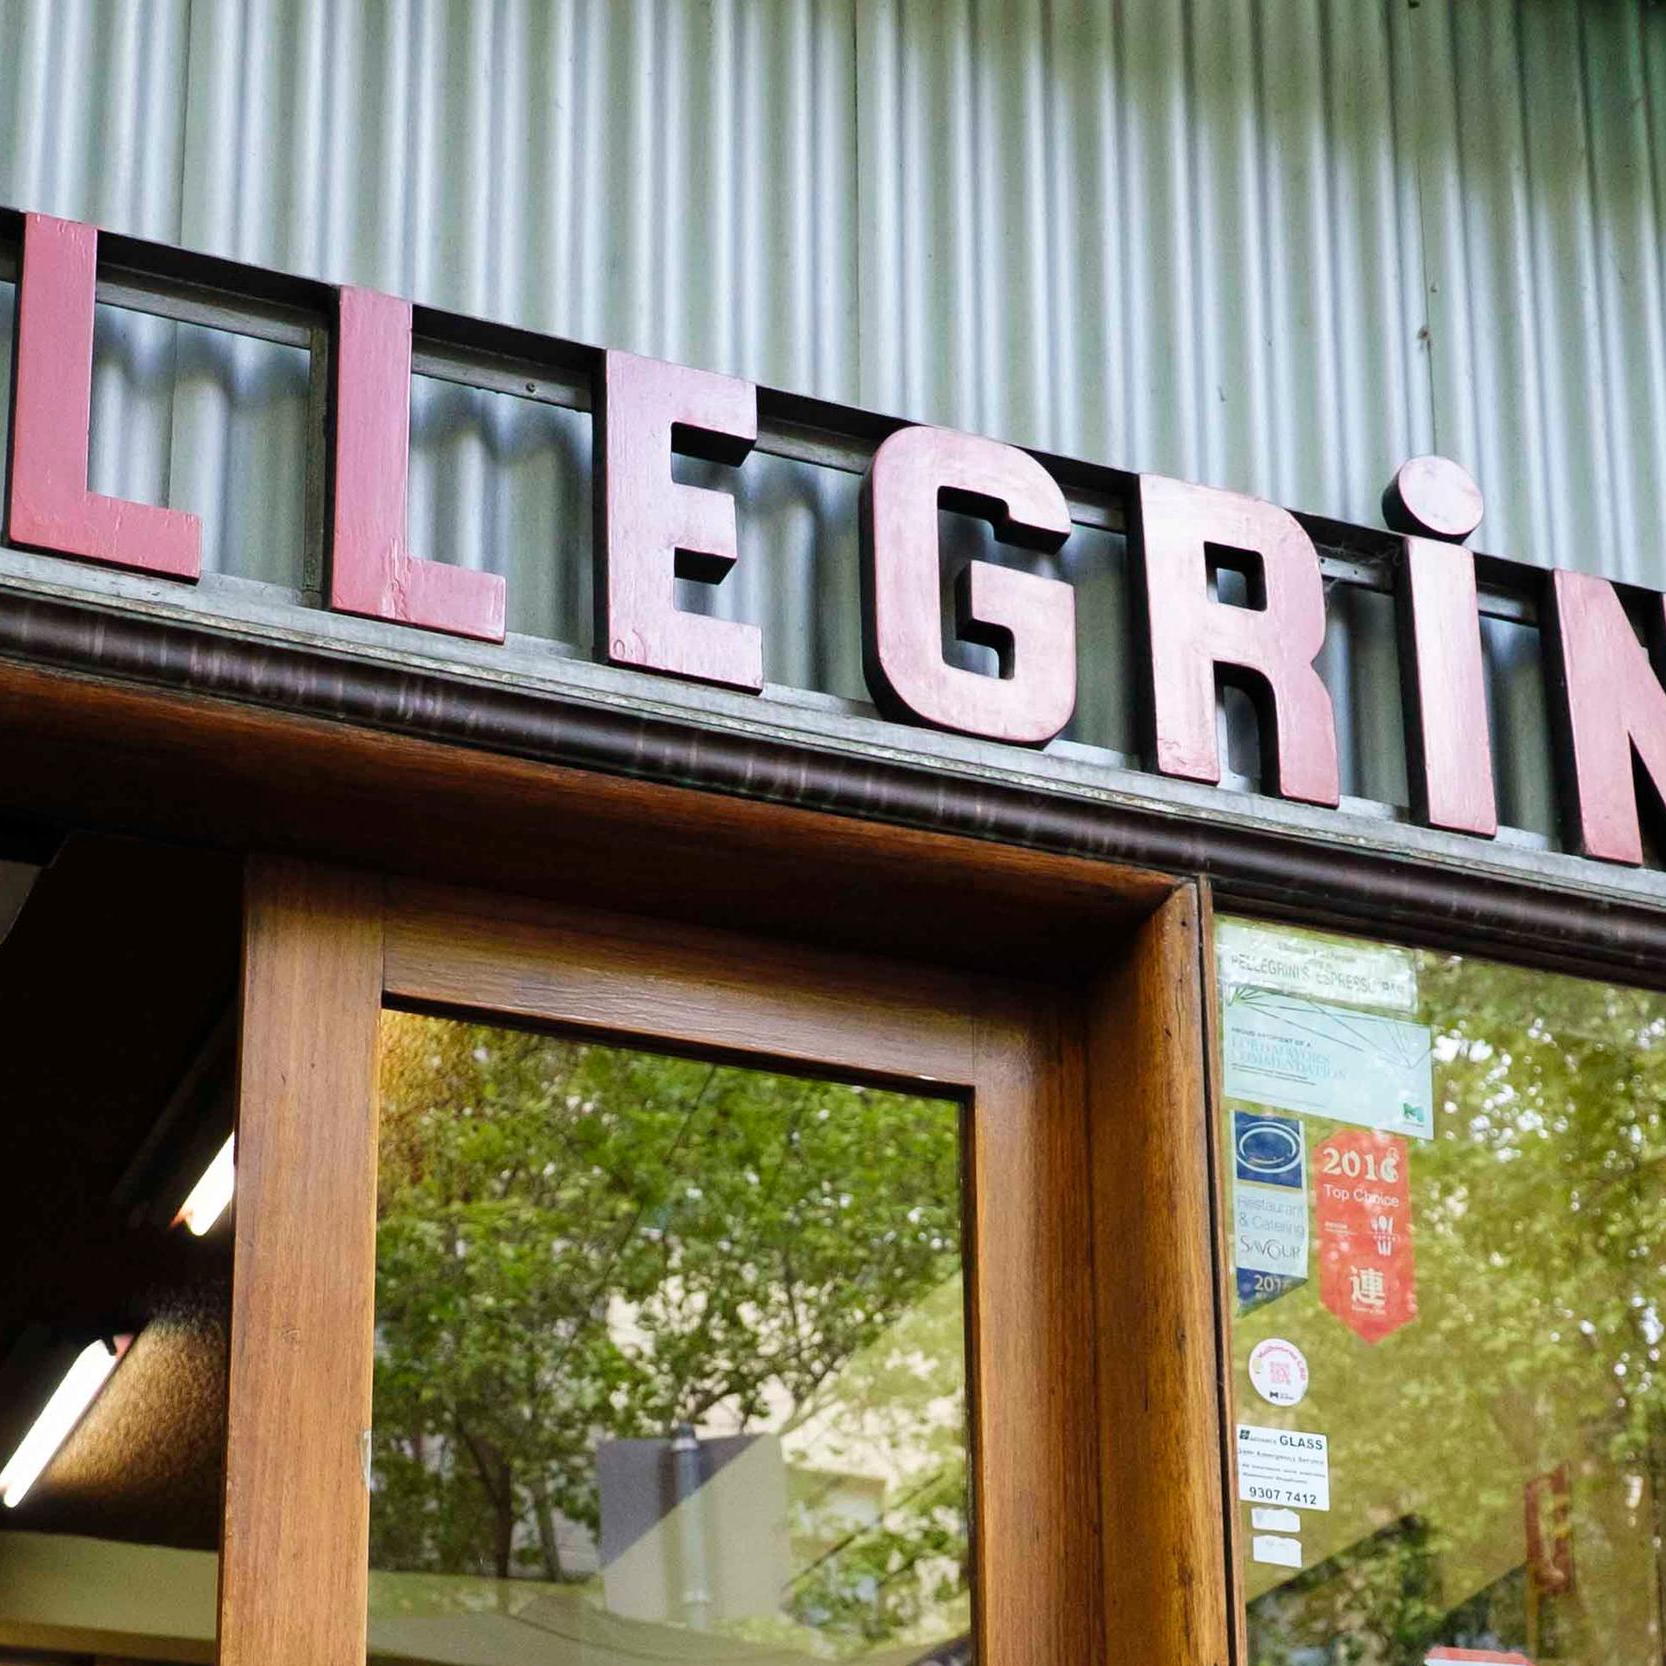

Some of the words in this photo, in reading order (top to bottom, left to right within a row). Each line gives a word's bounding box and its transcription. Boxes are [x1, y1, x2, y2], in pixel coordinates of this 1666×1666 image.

[1324, 1184, 1349, 1201] Top
[1353, 1188, 1400, 1208] Choice
[1252, 1215, 1305, 1237] Catering
[1279, 1435, 1323, 1451] GLASS
[1249, 1486, 1281, 1500] 9307
[1285, 1491, 1317, 1505] 7412
